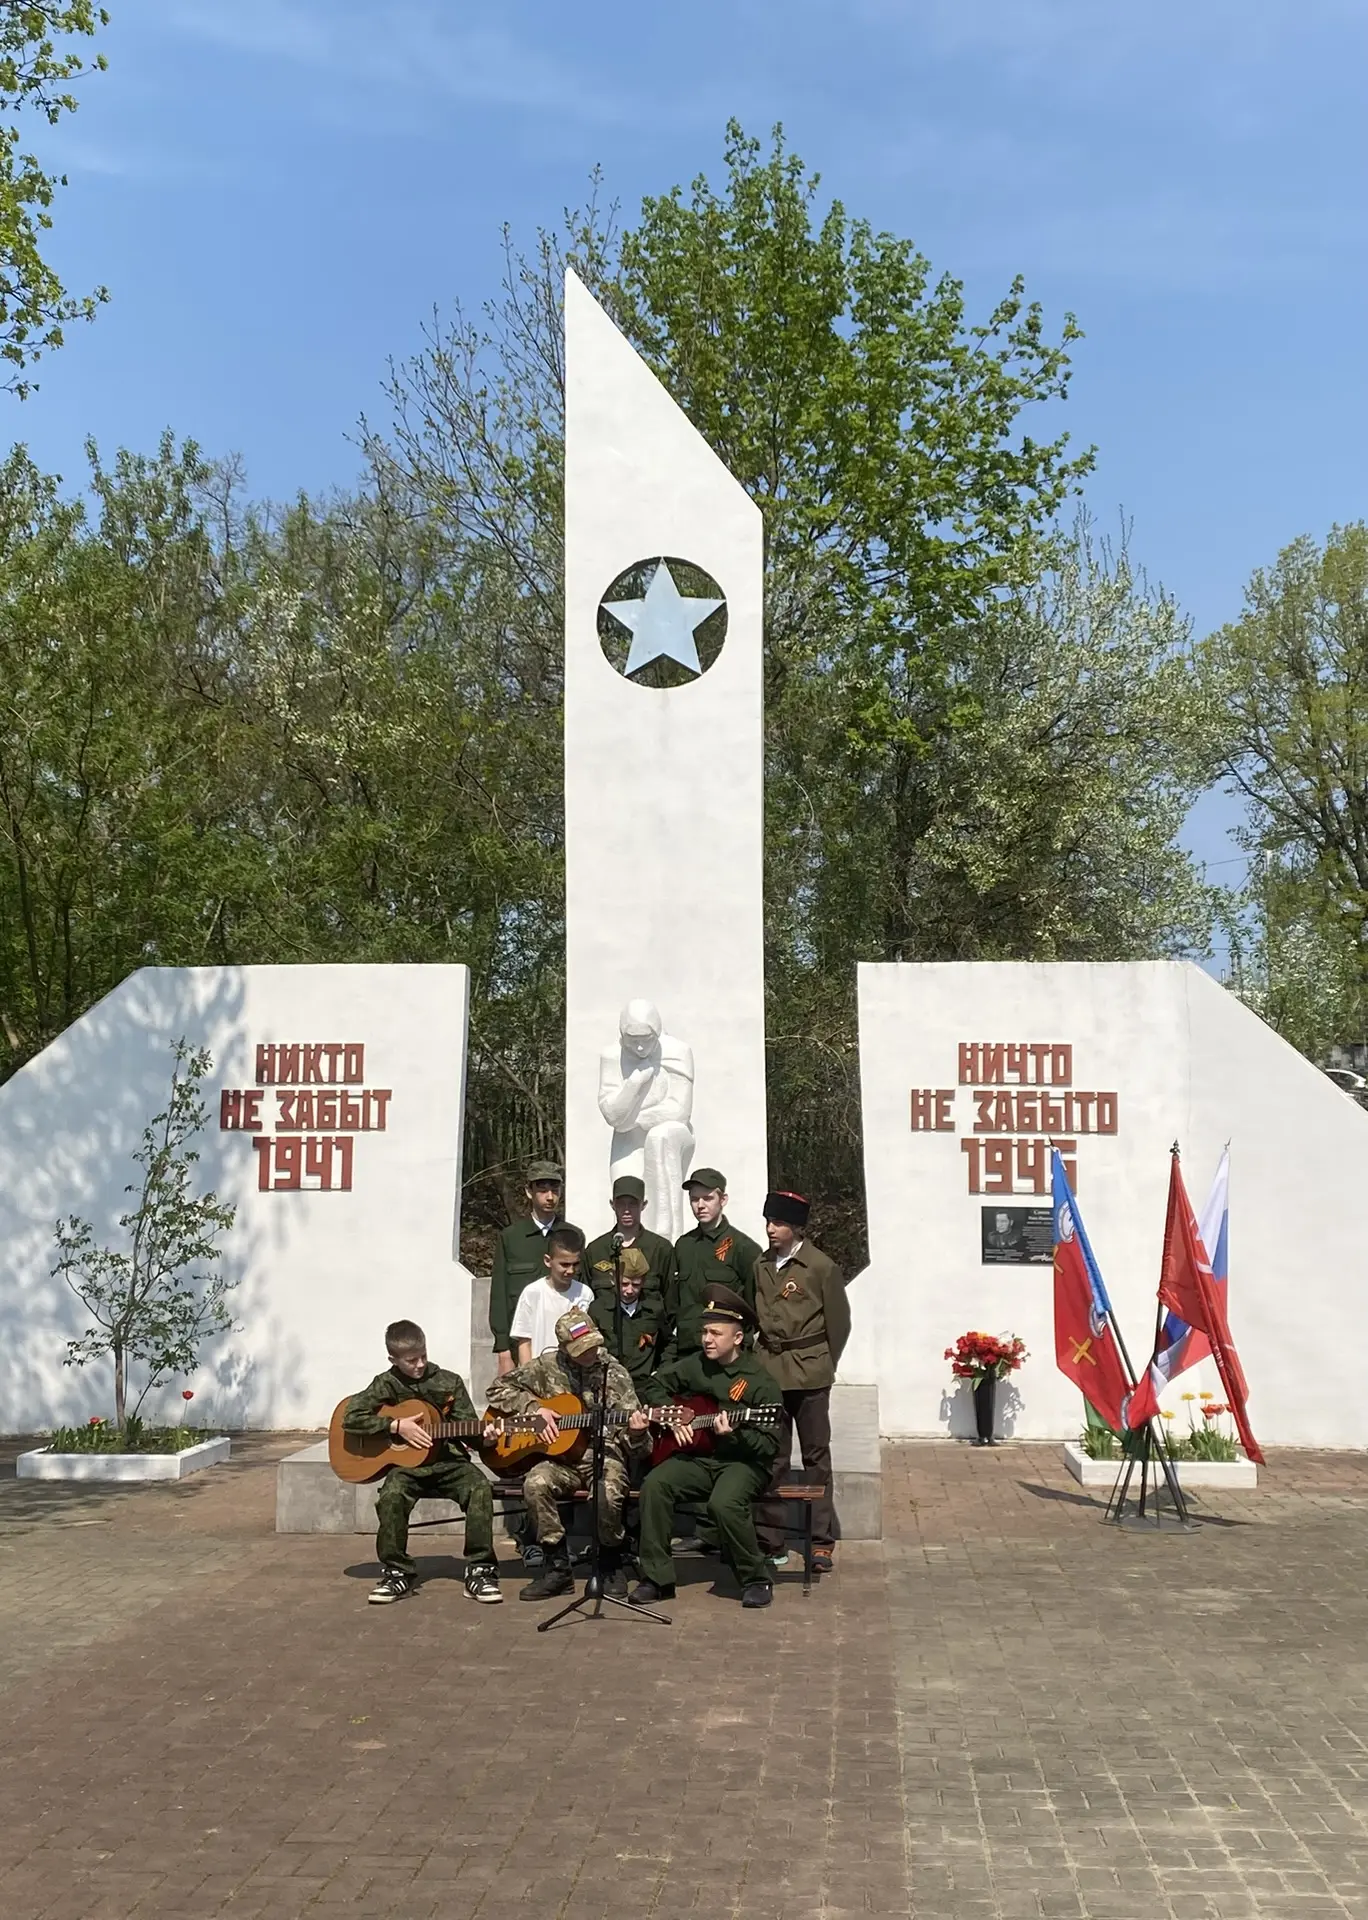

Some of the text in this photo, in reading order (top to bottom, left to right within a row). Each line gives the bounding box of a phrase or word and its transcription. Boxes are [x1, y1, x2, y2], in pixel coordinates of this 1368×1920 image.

[256, 1043, 364, 1084] НИКТО
[958, 1042, 1072, 1085] НИЧТО
[220, 1089, 392, 1131] НЕ ЗАБЫТ
[911, 1089, 1118, 1135] НЕ ЗАБЫТО
[252, 1136, 353, 1191] 1941
